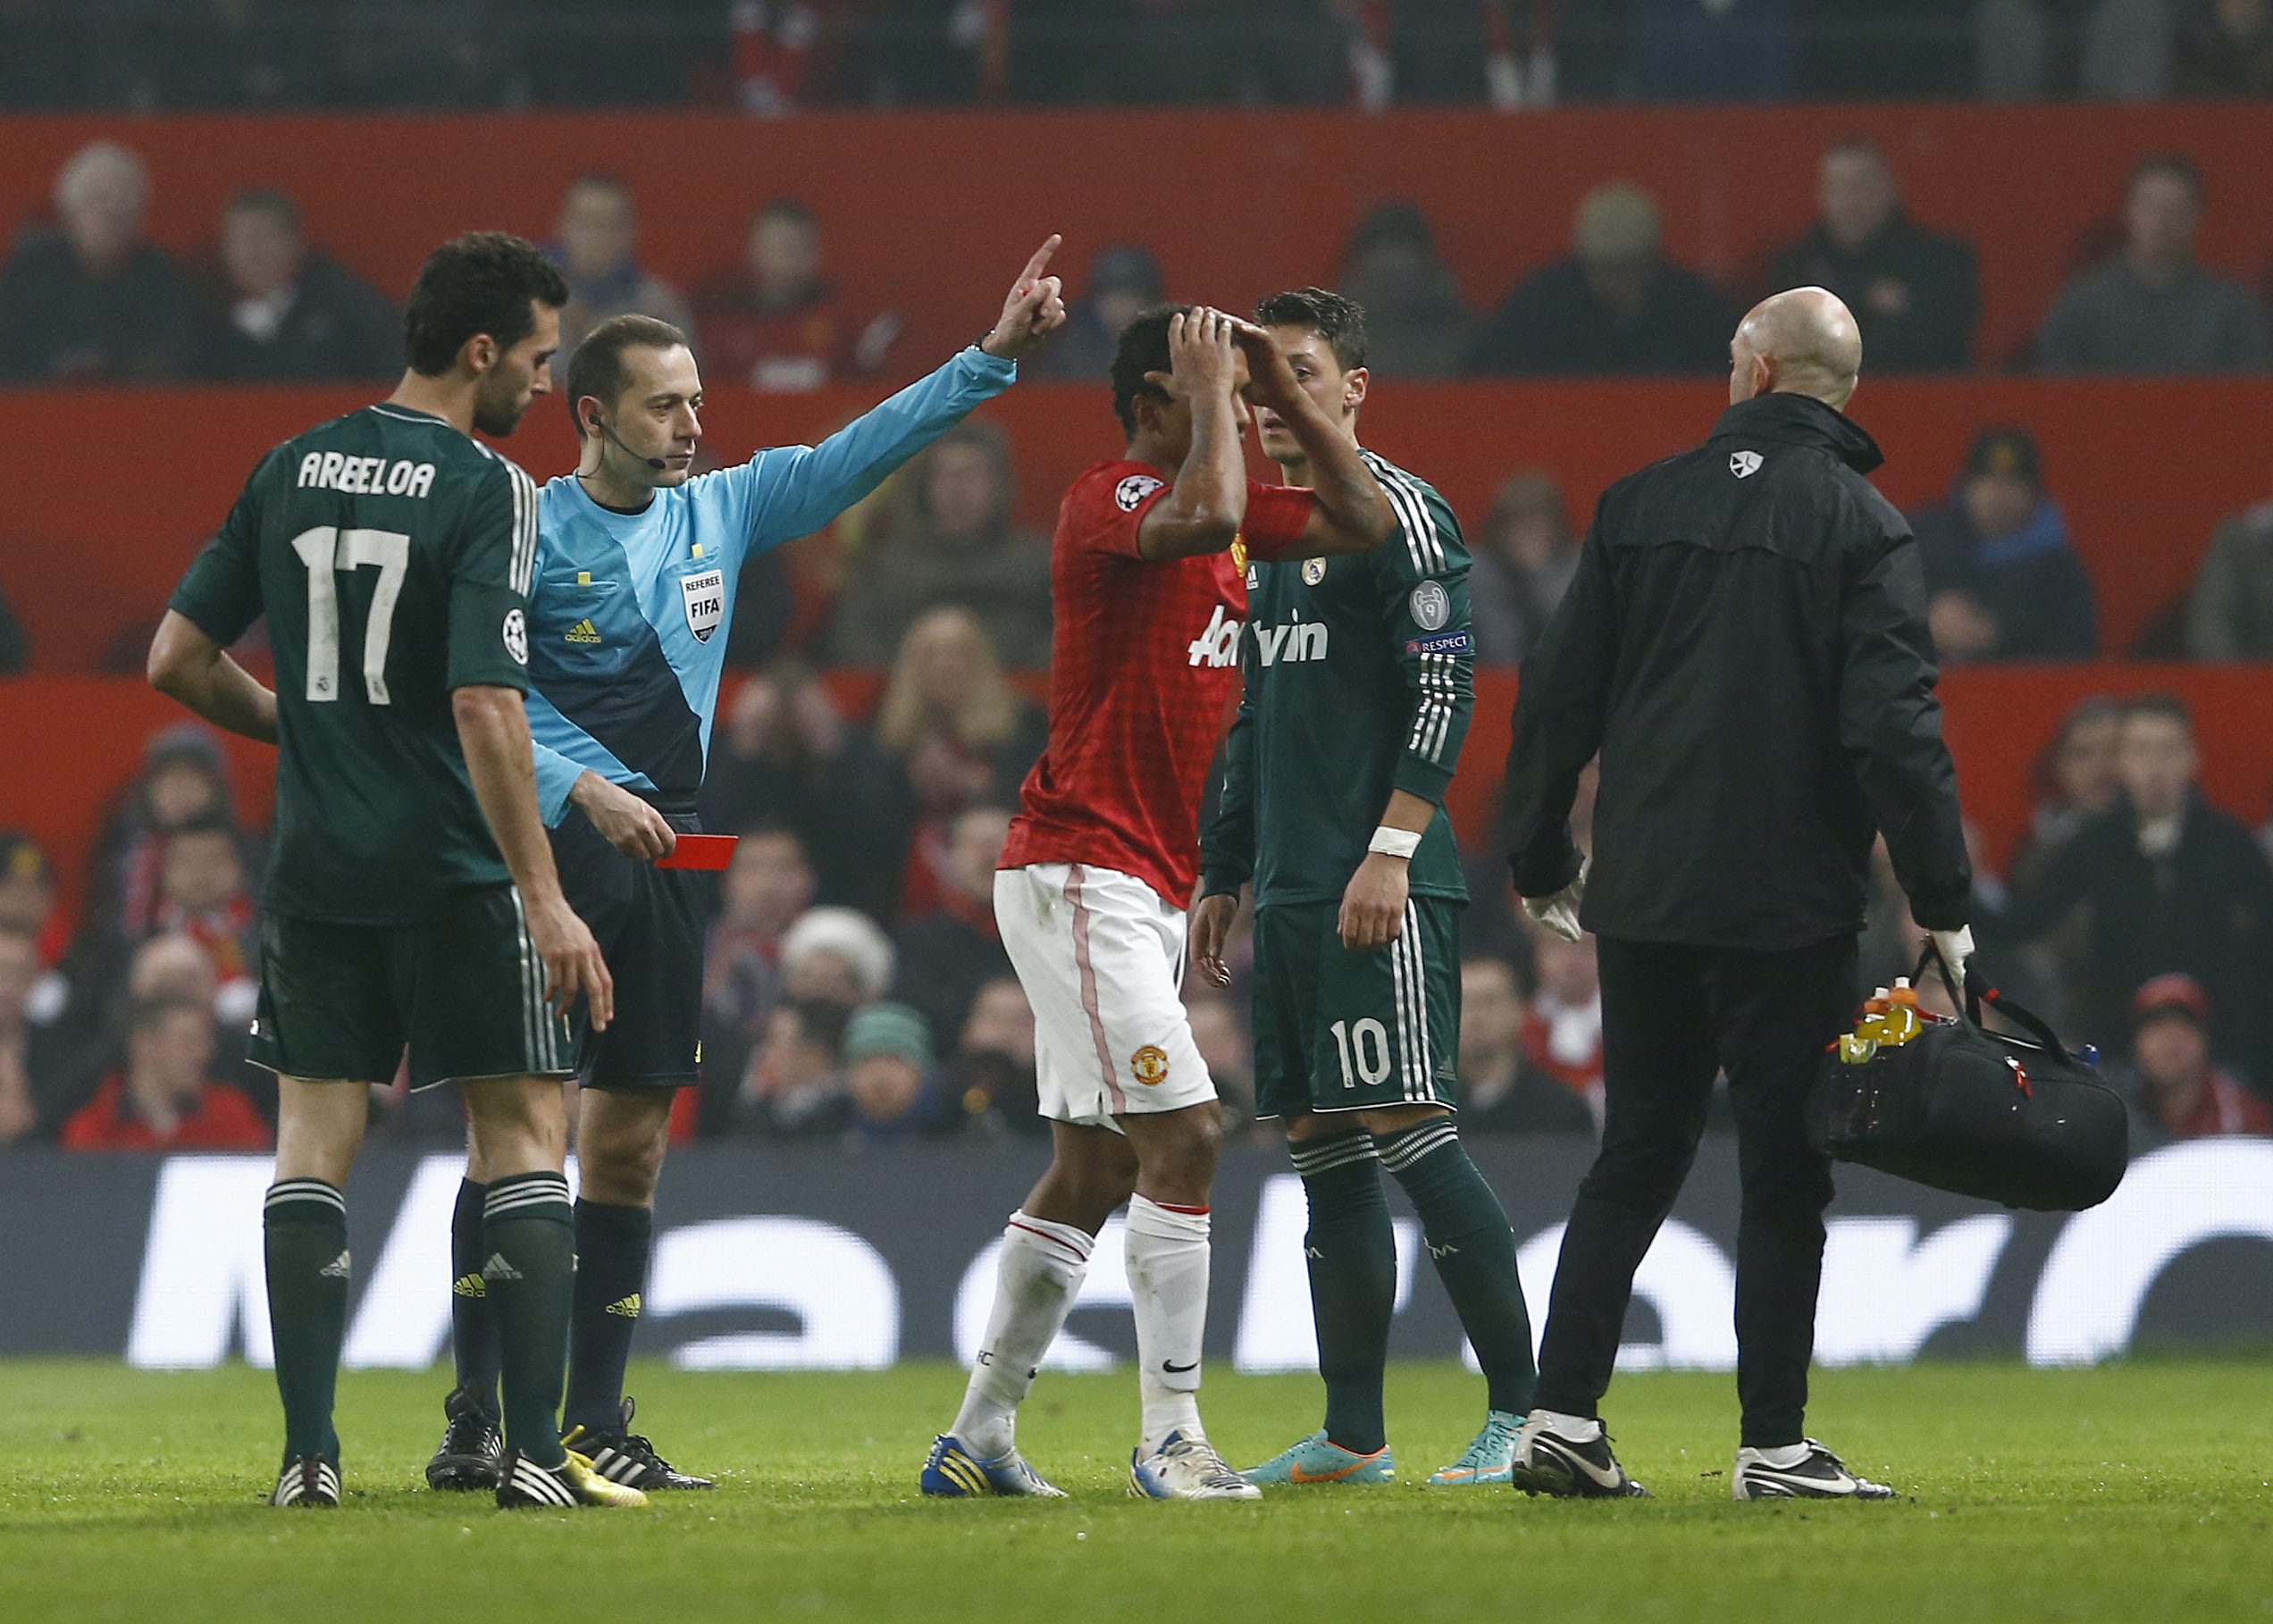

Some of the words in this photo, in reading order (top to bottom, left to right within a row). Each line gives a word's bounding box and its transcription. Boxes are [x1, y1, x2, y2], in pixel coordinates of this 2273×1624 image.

[297, 451, 436, 498] ARBELOA
[685, 575, 720, 591] REFEREE
[291, 525, 411, 706] 17
[691, 598, 720, 618] FIFA
[1252, 607, 1329, 667] win
[1422, 636, 1467, 652] RESPECT
[1329, 1017, 1391, 1088] 10
